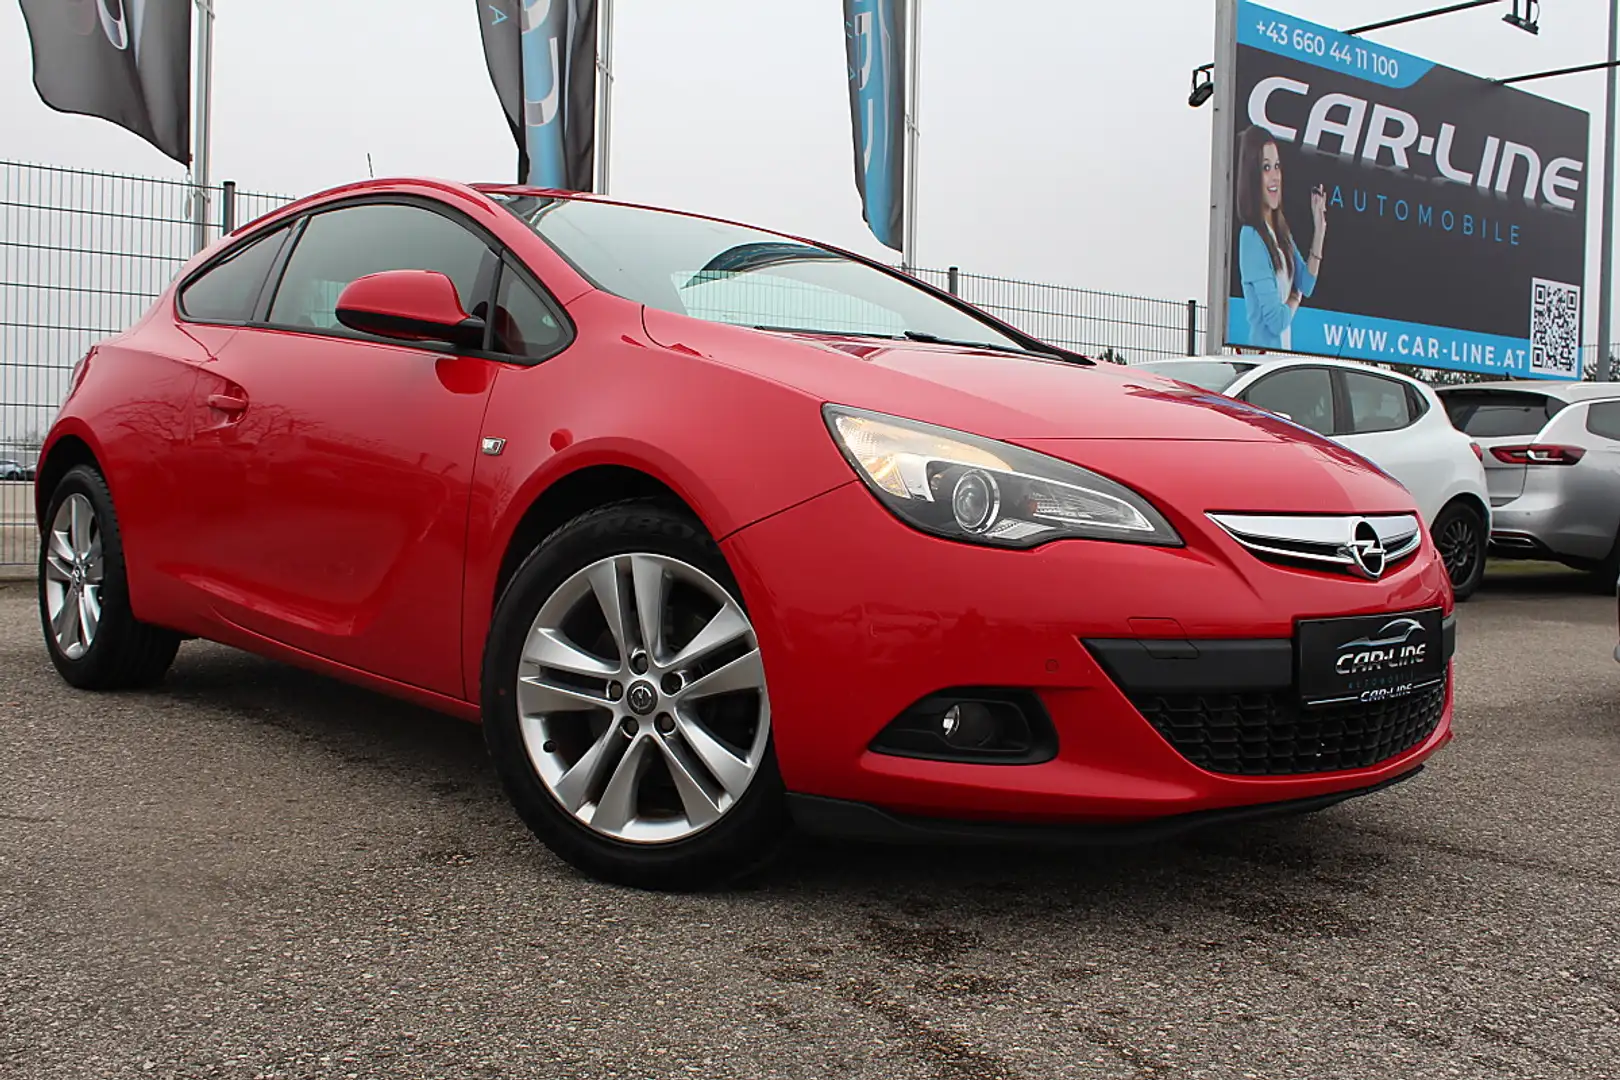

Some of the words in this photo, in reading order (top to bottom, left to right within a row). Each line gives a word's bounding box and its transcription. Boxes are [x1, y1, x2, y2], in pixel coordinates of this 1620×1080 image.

[1256, 20, 1288, 45] +43
[1293, 29, 1325, 56] 660
[1329, 41, 1352, 65] 44
[1355, 47, 1367, 70] 11
[1371, 53, 1398, 79] 100
[1331, 185, 1520, 246] AUTOMOBILE
[1323, 323, 1526, 369] WWW.CAR-LINE.AT
